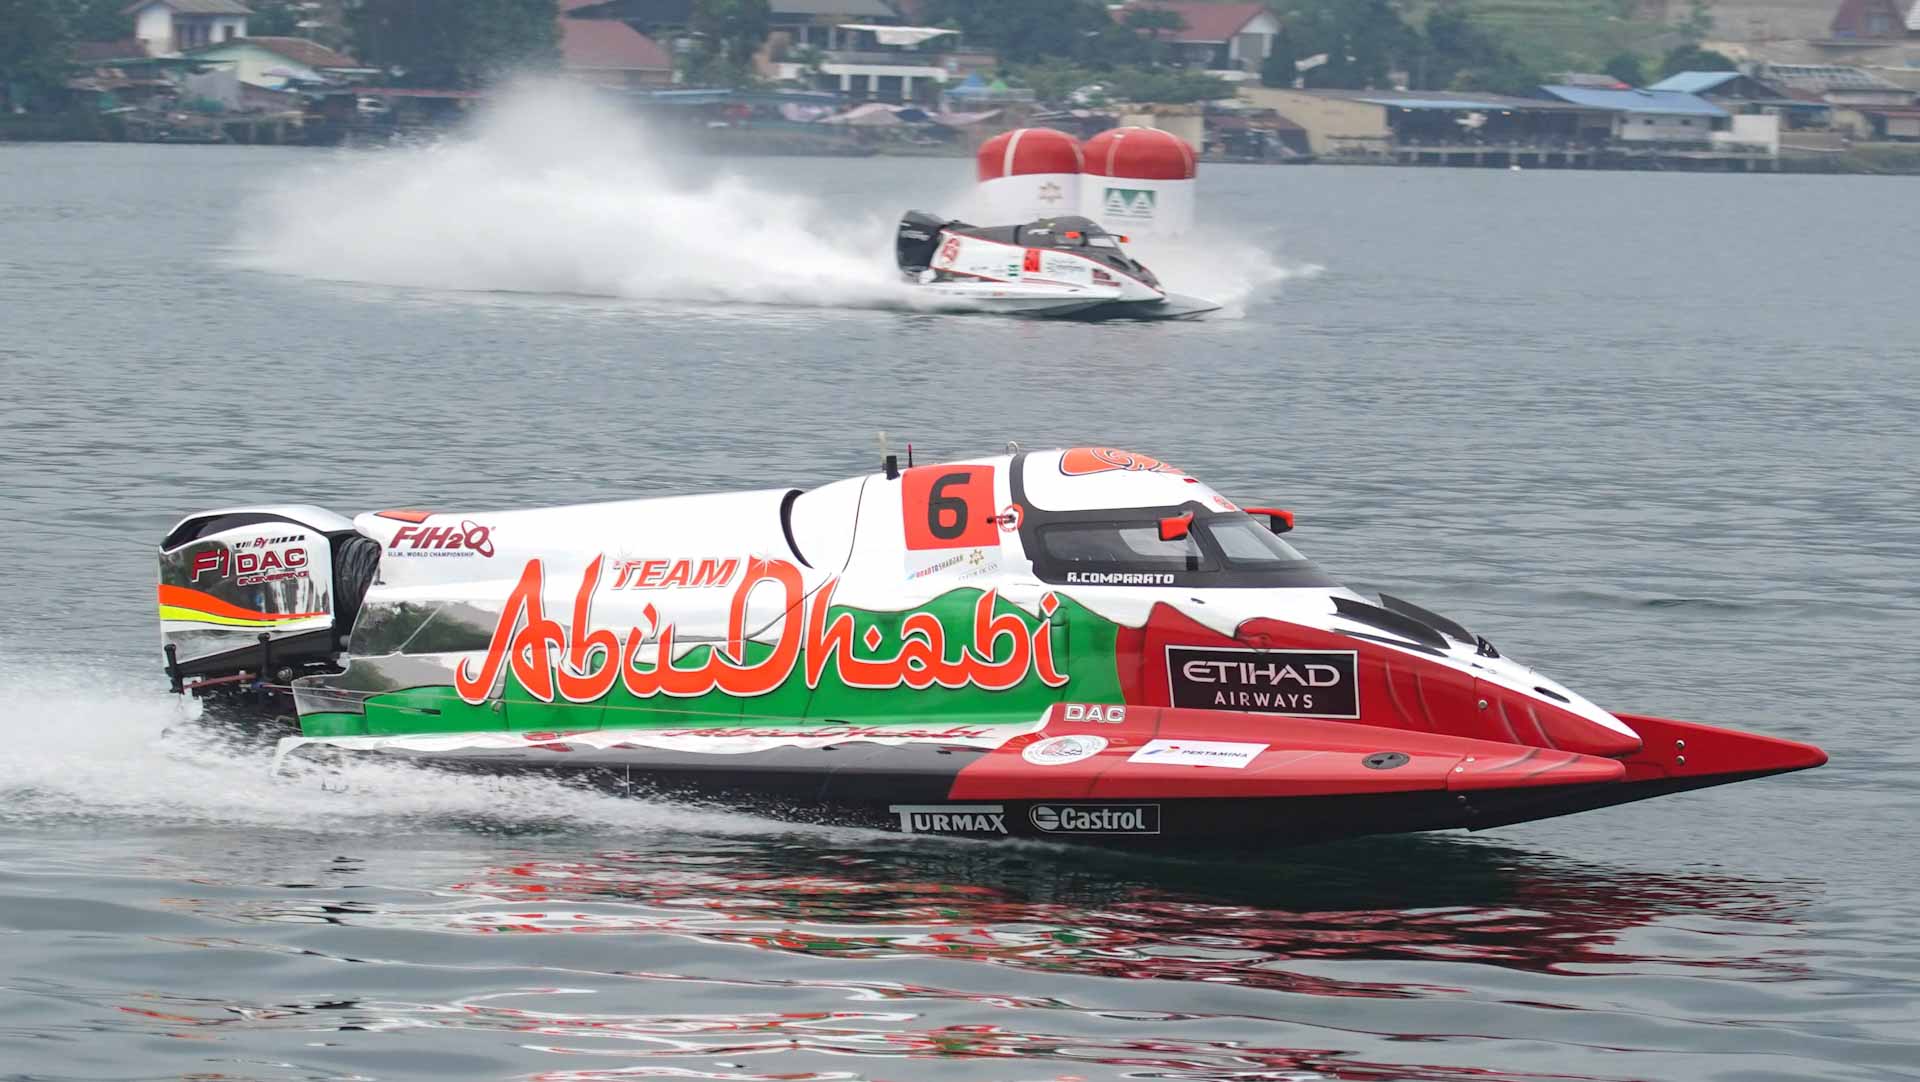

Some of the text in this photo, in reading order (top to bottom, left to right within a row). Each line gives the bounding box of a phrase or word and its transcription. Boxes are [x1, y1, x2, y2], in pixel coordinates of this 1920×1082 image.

[926, 472, 972, 541] 6
[191, 547, 231, 583] F1
[235, 547, 310, 576] DAC
[611, 557, 740, 591] TEAM
[1066, 572, 1175, 585] A.COMPARATO
[1183, 660, 1341, 688] ETIHAD
[1063, 703, 1126, 723] DAC
[1214, 691, 1314, 710] AIRWAYS
[1181, 749, 1248, 759] PERTAMINA
[889, 805, 1009, 834] TURMAX
[1060, 807, 1146, 831] Castrol
